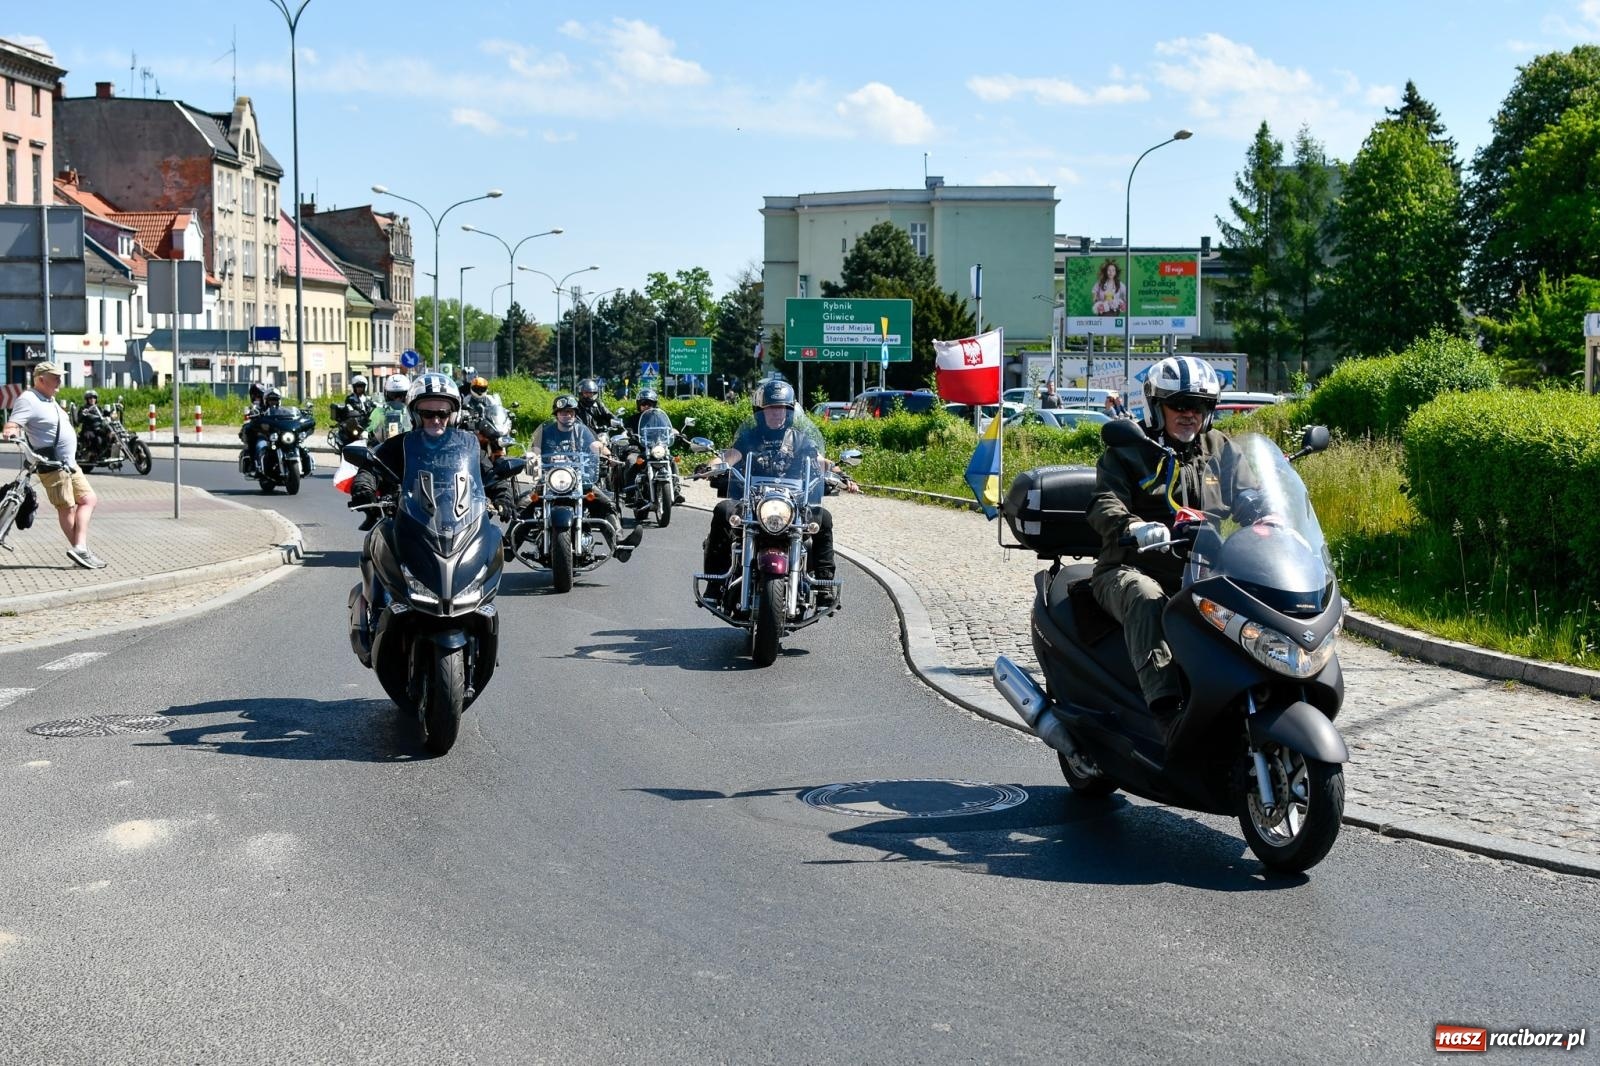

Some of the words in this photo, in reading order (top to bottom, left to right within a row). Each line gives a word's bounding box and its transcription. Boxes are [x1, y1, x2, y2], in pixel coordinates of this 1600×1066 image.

[823, 302, 852, 311] Rybnik
[822, 312, 855, 321] Gliwice
[848, 324, 872, 332] Miejski
[862, 335, 899, 343] Powiaowe
[822, 349, 849, 357] Opole
